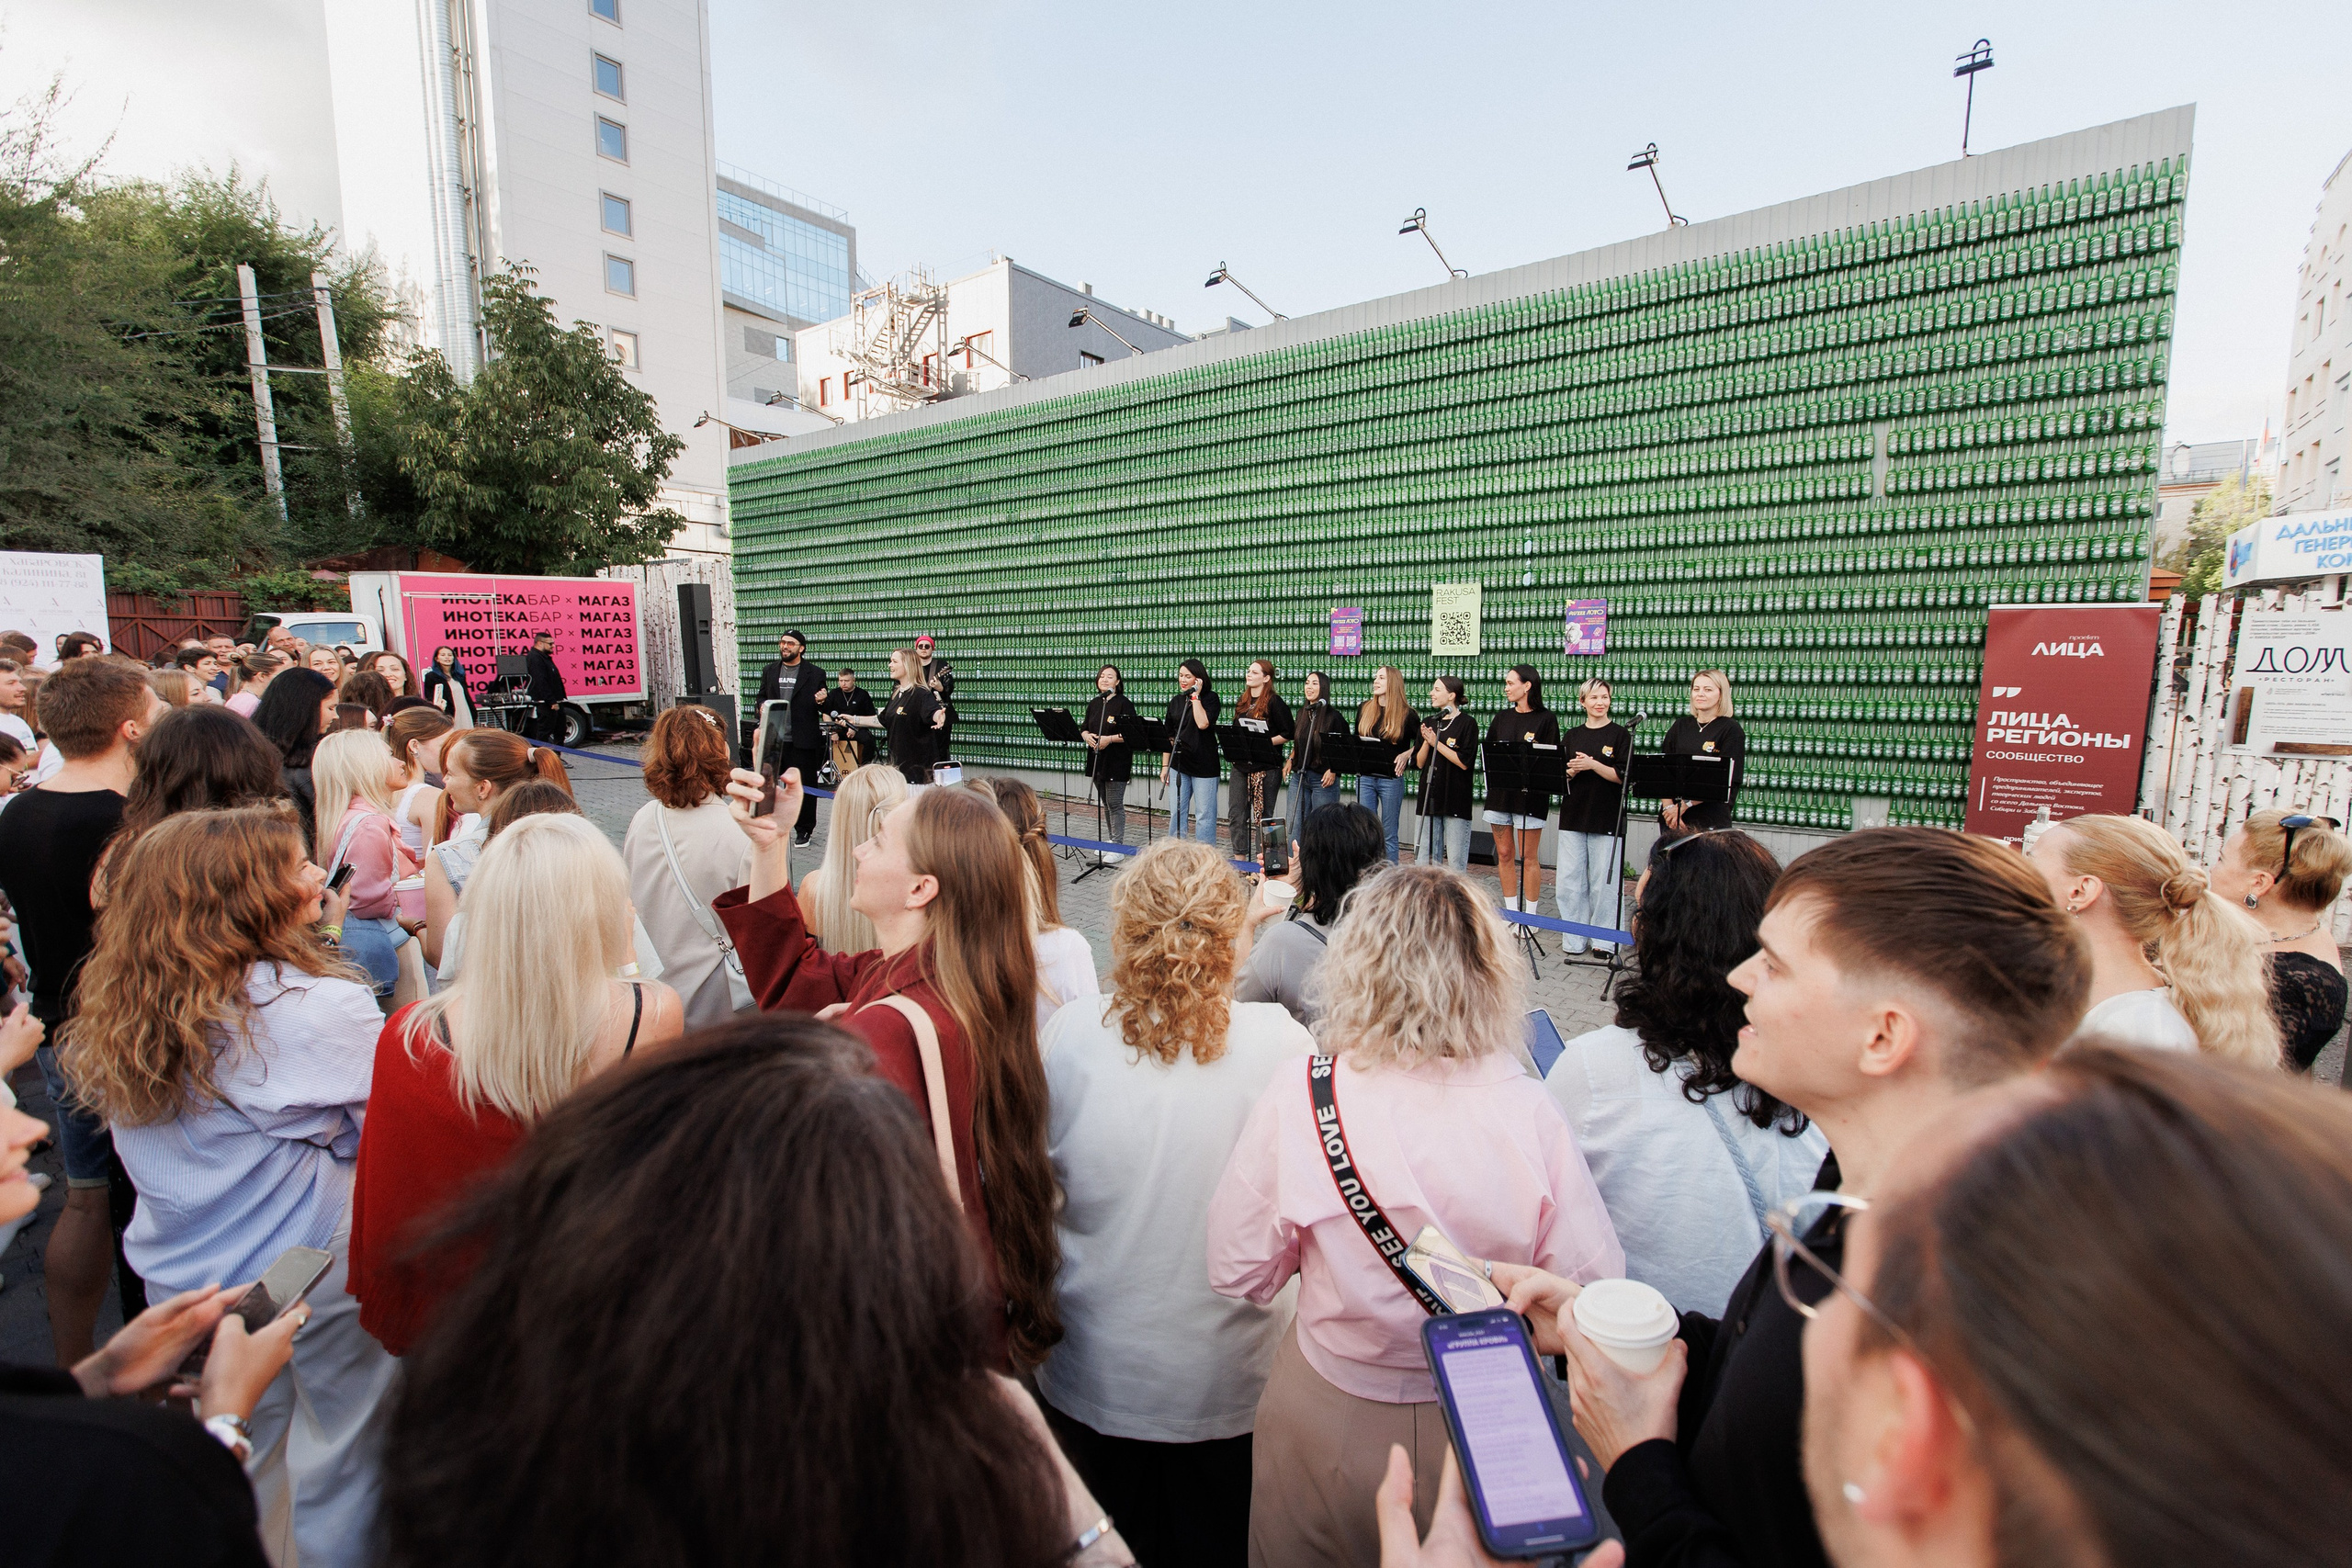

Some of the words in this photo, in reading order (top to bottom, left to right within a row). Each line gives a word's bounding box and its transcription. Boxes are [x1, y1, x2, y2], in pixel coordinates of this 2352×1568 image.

[2294, 535, 2352, 553] ГЕНЕР
[1436, 587, 1476, 597] RAKUSA
[578, 595, 630, 606] МАГАЗ
[1436, 596, 1460, 605] FEST
[443, 611, 561, 623] ИНОТЕКАБАР
[580, 612, 631, 623] МАГАЗ
[581, 628, 632, 638] МАГАЗ
[582, 644, 633, 655] МАГАЗ
[2031, 642, 2105, 659] ЛИЦА
[583, 660, 634, 671] МАГАЗ
[2245, 646, 2350, 673] ДОМ
[1987, 711, 2080, 730] ЛИЦА.
[1986, 728, 2131, 750] РЕГИОНЫ
[1985, 750, 2085, 764] СООБЩЕСТВО
[1992, 784, 2062, 794] предпринимателей,
[1993, 776, 2048, 785] Пространство,
[2049, 780, 2104, 789] объединяющее
[1316, 1104, 1351, 1172] LOVE
[1339, 1178, 1379, 1226] YOU
